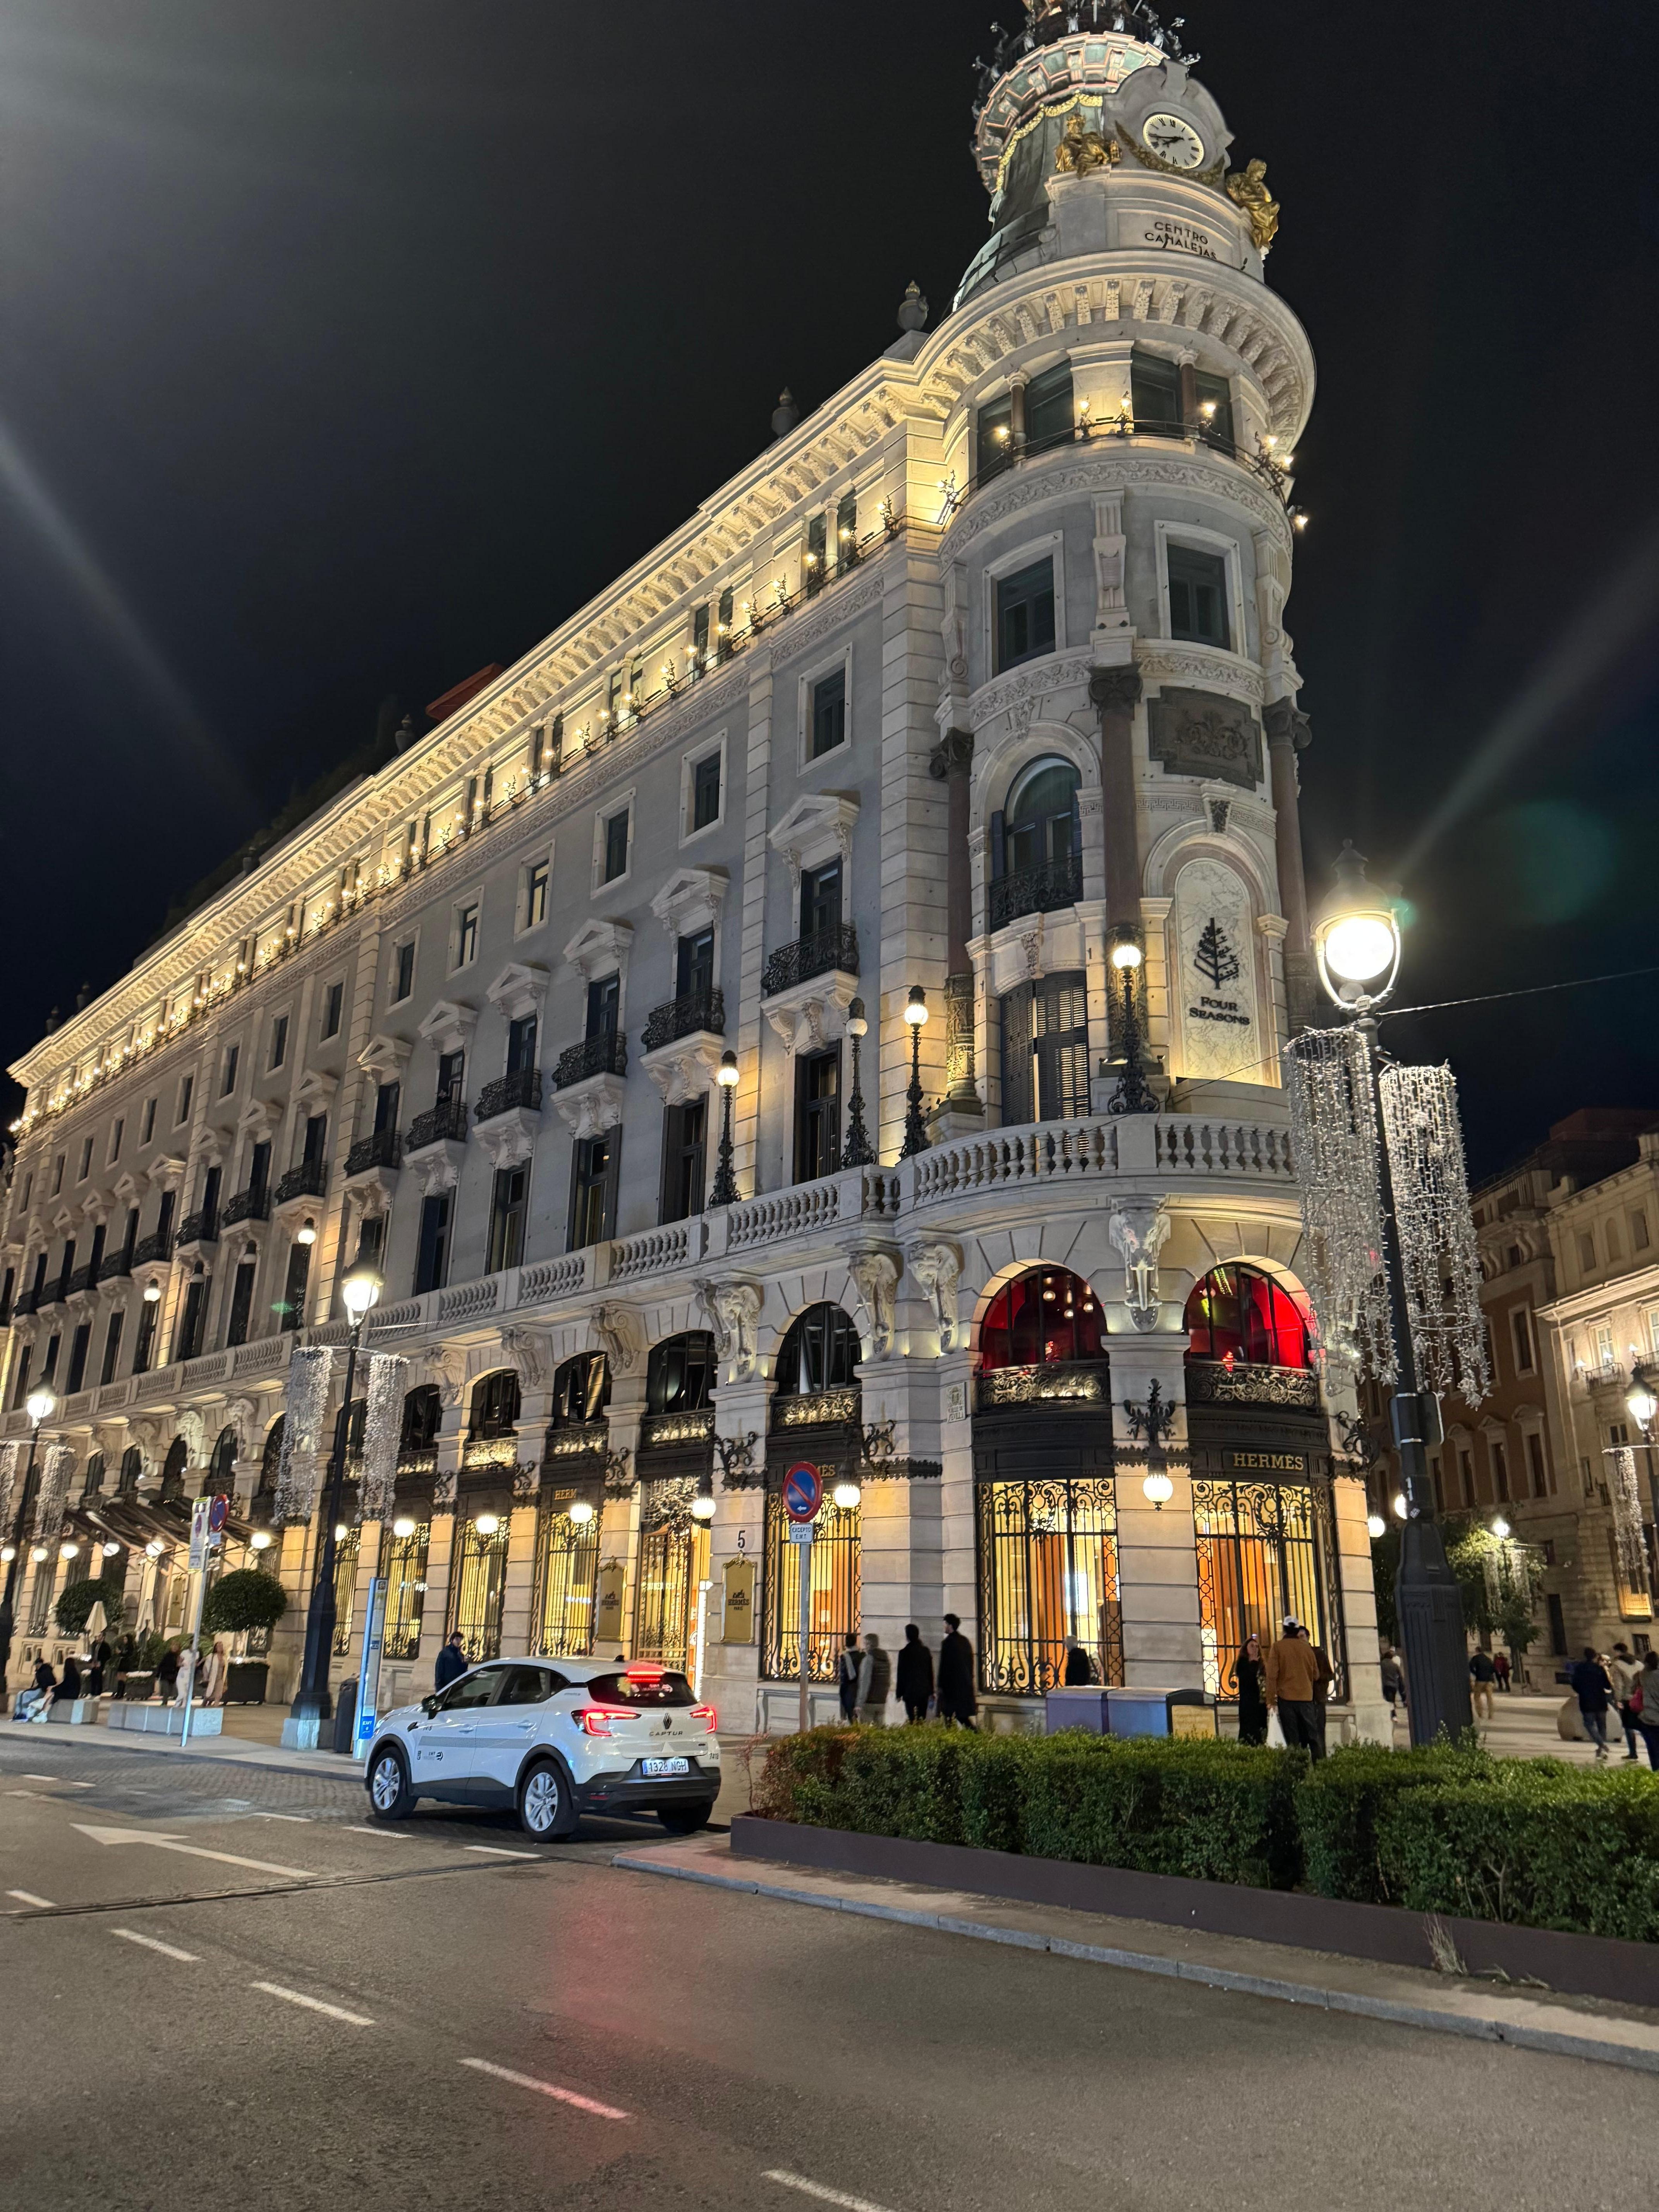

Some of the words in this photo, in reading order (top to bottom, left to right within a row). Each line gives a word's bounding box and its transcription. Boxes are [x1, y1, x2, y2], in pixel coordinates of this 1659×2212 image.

[1155, 222, 1208, 244] CENTRO
[1145, 232, 1217, 260] CANALEJAS
[1201, 996, 1238, 1012] FOUR
[1189, 1007, 1250, 1025] SEASONS
[1233, 1453, 1304, 1471] HERMÈS
[555, 1488, 577, 1500] HERM
[738, 1530, 745, 1549] 5
[649, 1761, 668, 1772] 1328
[671, 1760, 686, 1771] NGH
